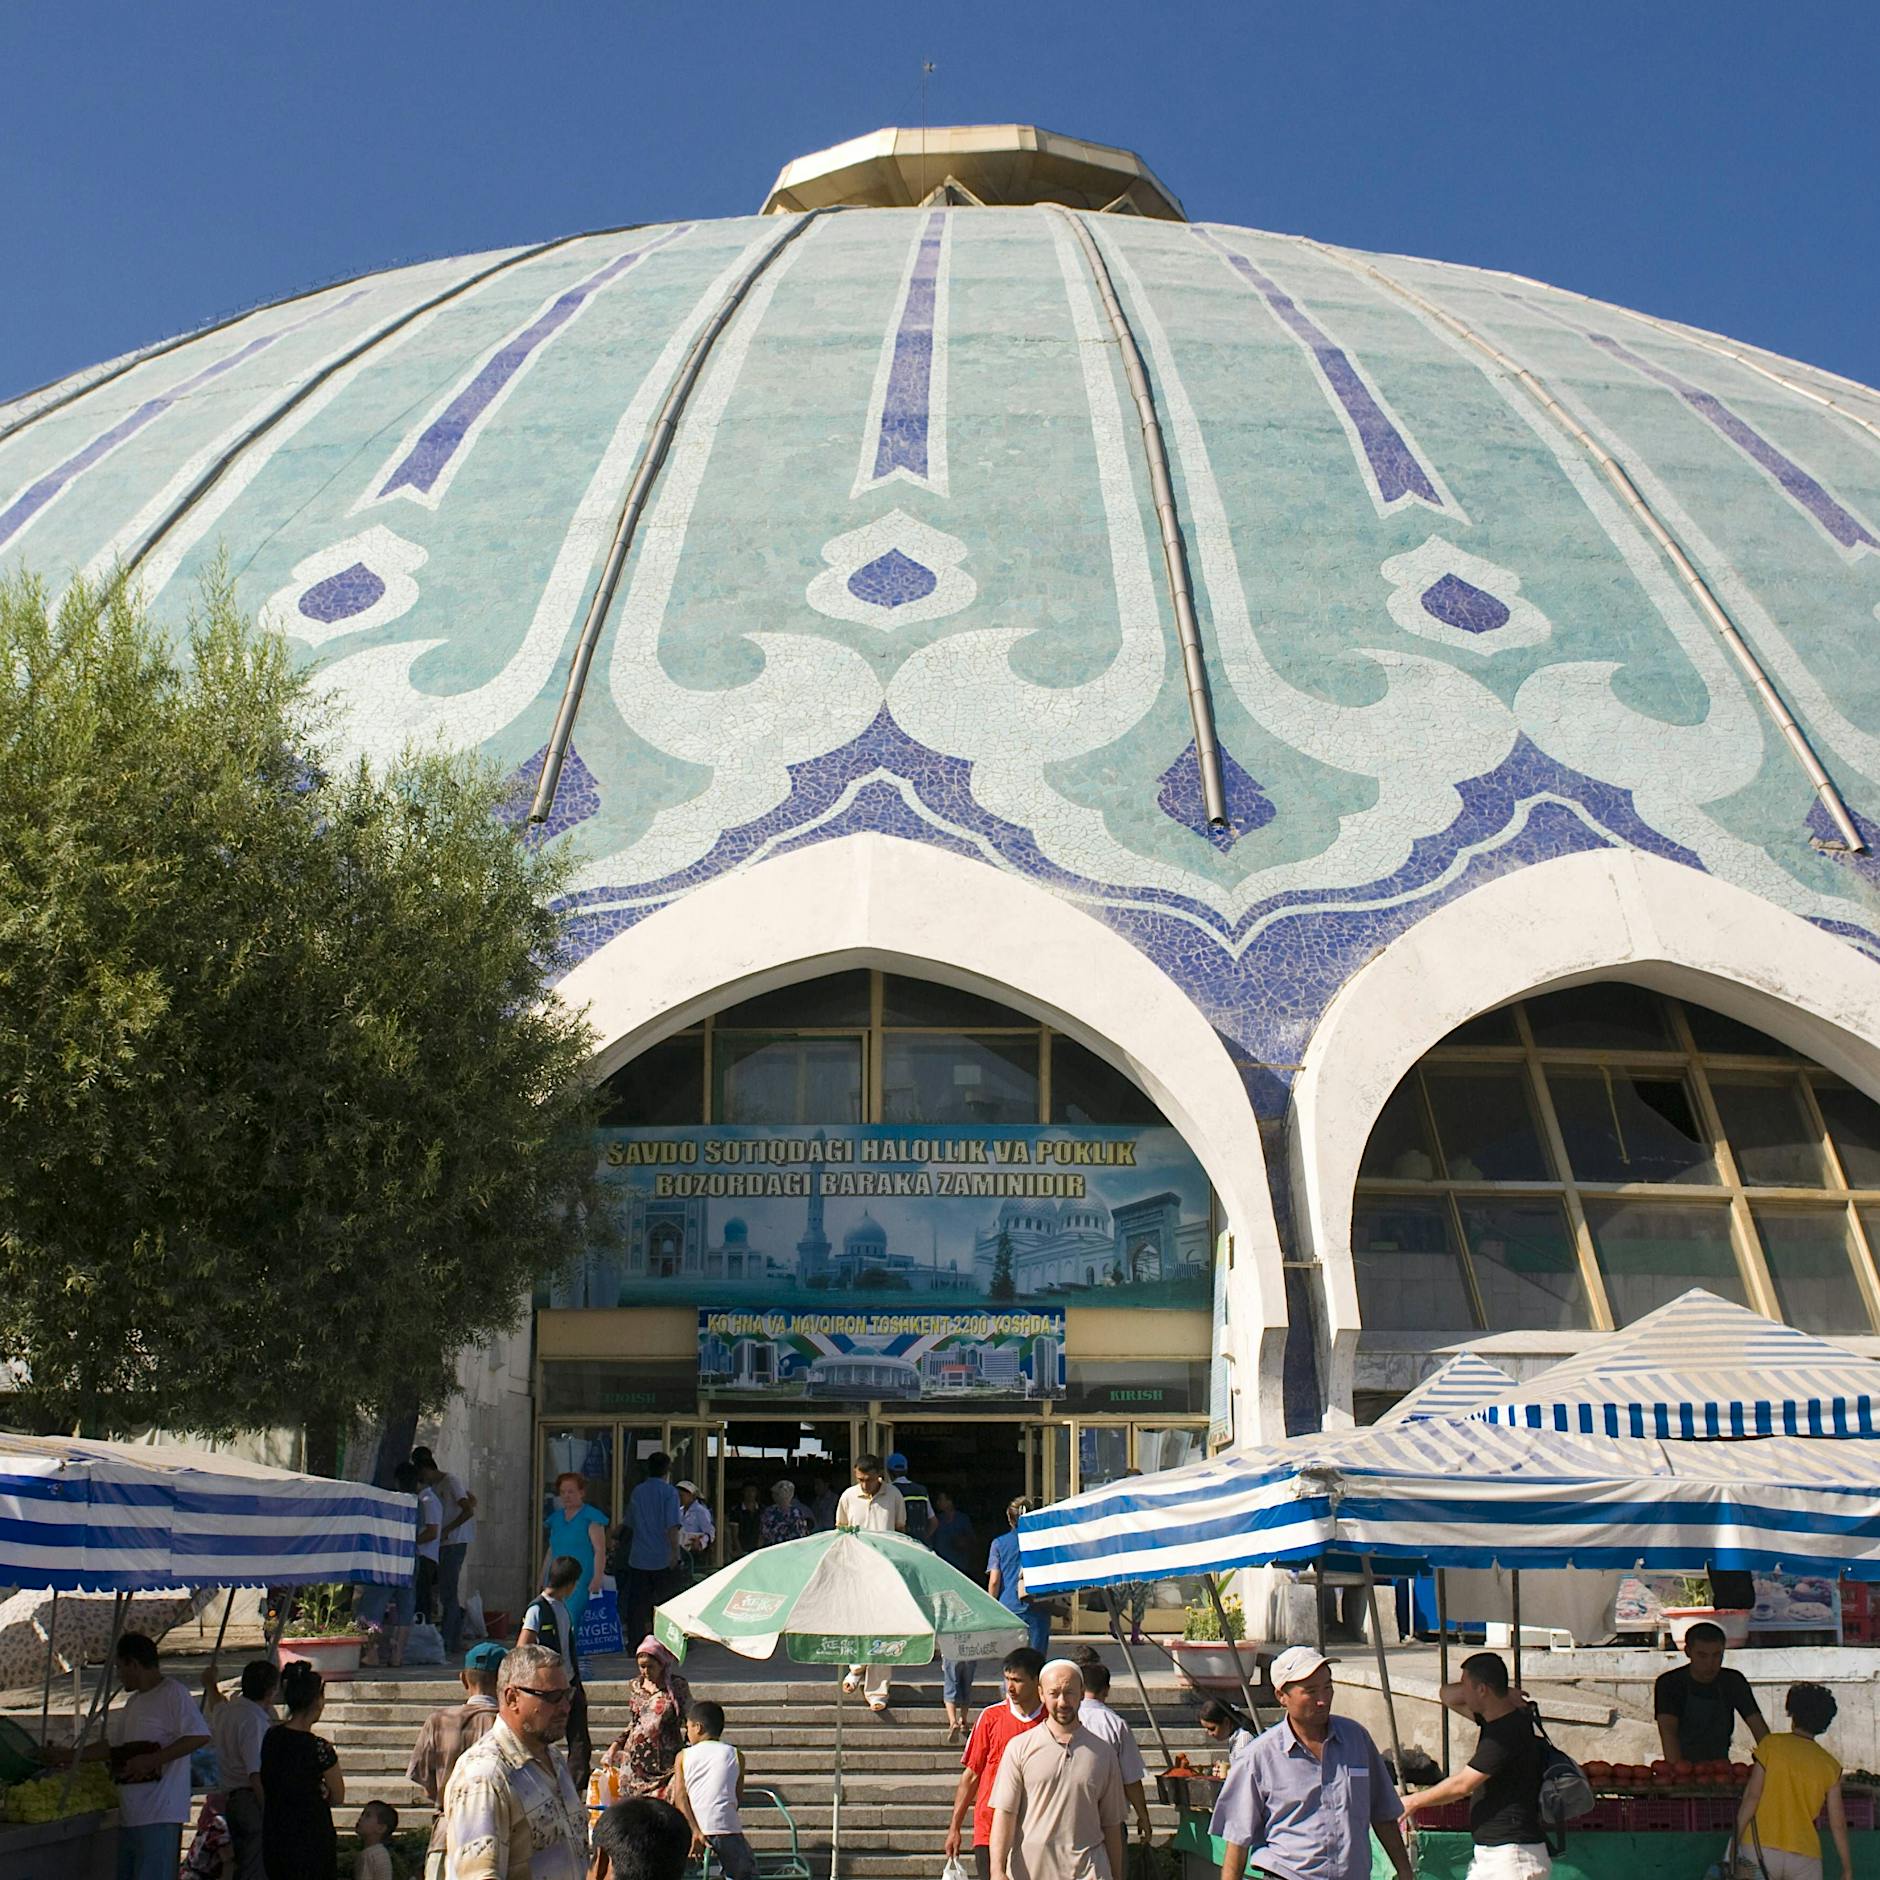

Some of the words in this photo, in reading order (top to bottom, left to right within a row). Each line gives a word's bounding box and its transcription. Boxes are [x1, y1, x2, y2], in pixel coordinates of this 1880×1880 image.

[606, 1140, 698, 1165] SAVDO
[704, 1139, 853, 1166] SOTIQDAGI
[860, 1138, 989, 1164] HALOLLIK
[992, 1140, 1031, 1165] VA
[1036, 1140, 1137, 1166] POKLIK
[655, 1173, 811, 1198] BOZORDAGI
[819, 1172, 932, 1198] BARAKA
[936, 1172, 1085, 1199] ZAMINIDIR
[768, 1314, 787, 1334] VA
[791, 1315, 867, 1335] NAVQIRON
[1109, 1389, 1163, 1401] KIRISH
